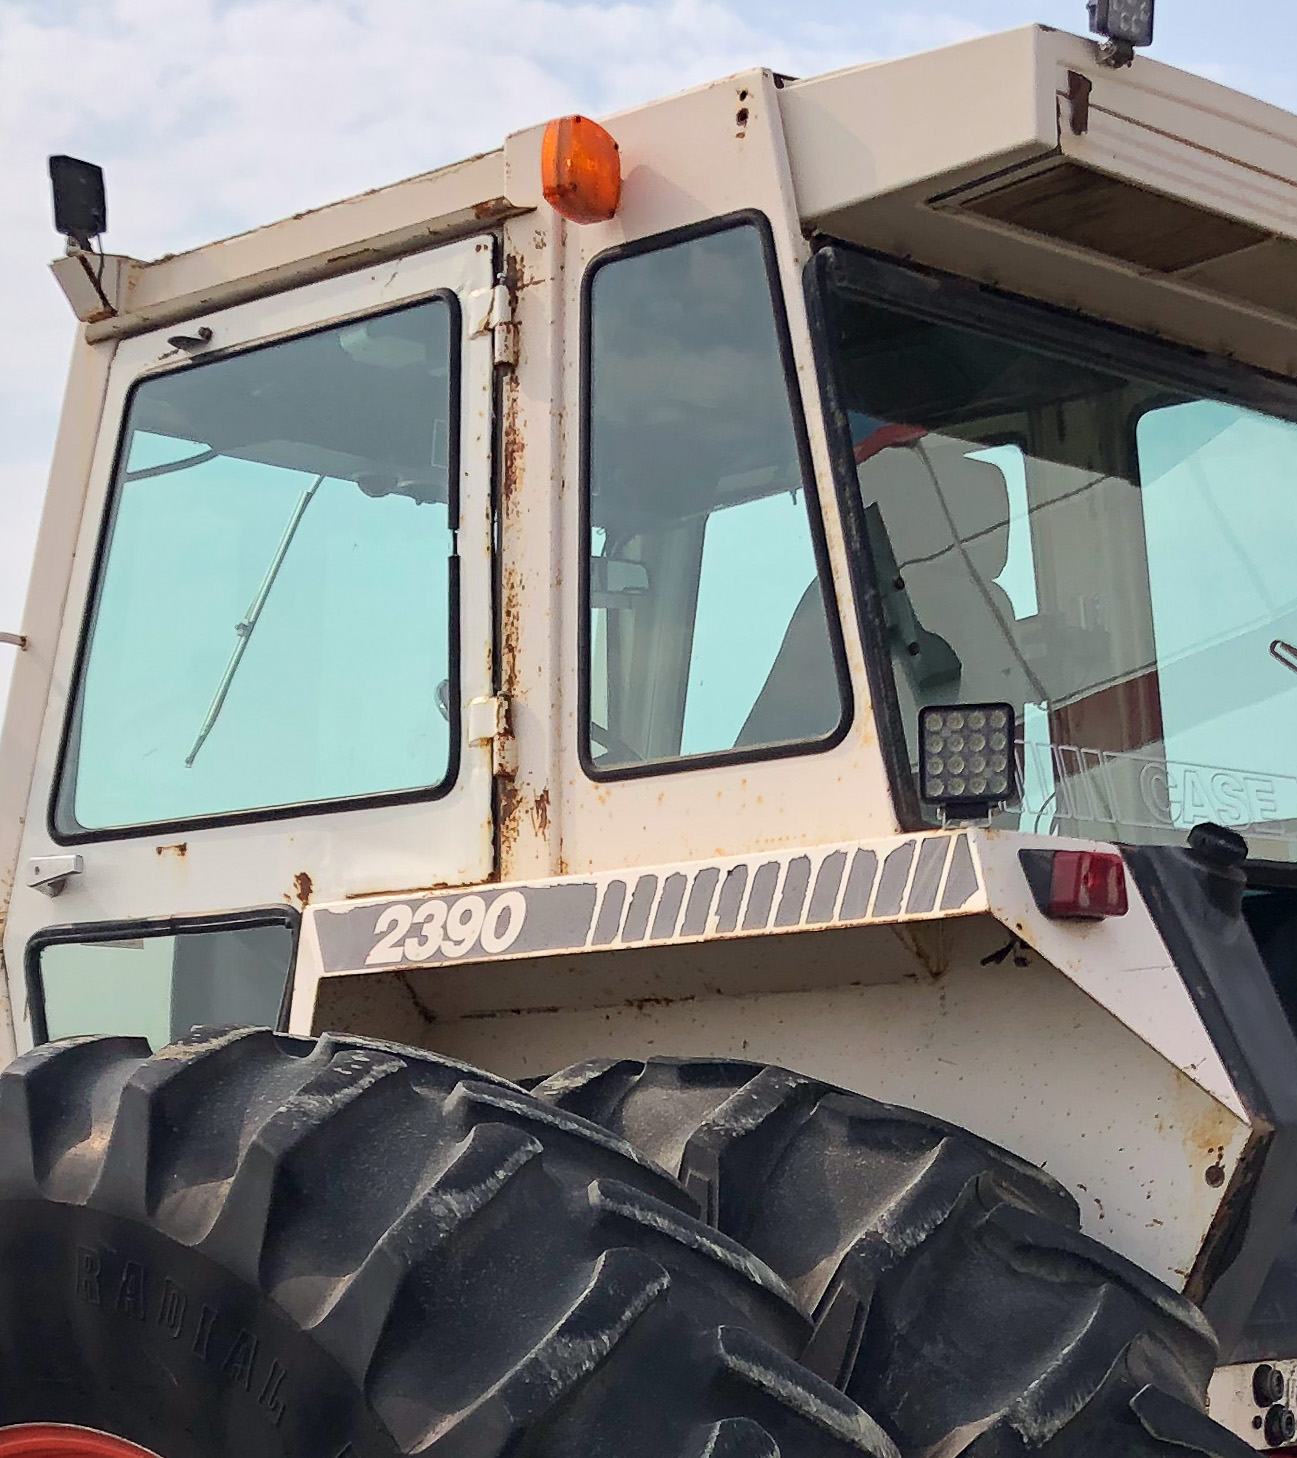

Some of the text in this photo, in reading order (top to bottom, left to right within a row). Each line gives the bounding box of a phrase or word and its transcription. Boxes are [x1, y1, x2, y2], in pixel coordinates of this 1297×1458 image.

[1140, 762, 1277, 830] CASE
[365, 890, 526, 965] 2390
[73, 1245, 290, 1429] RADIAL
